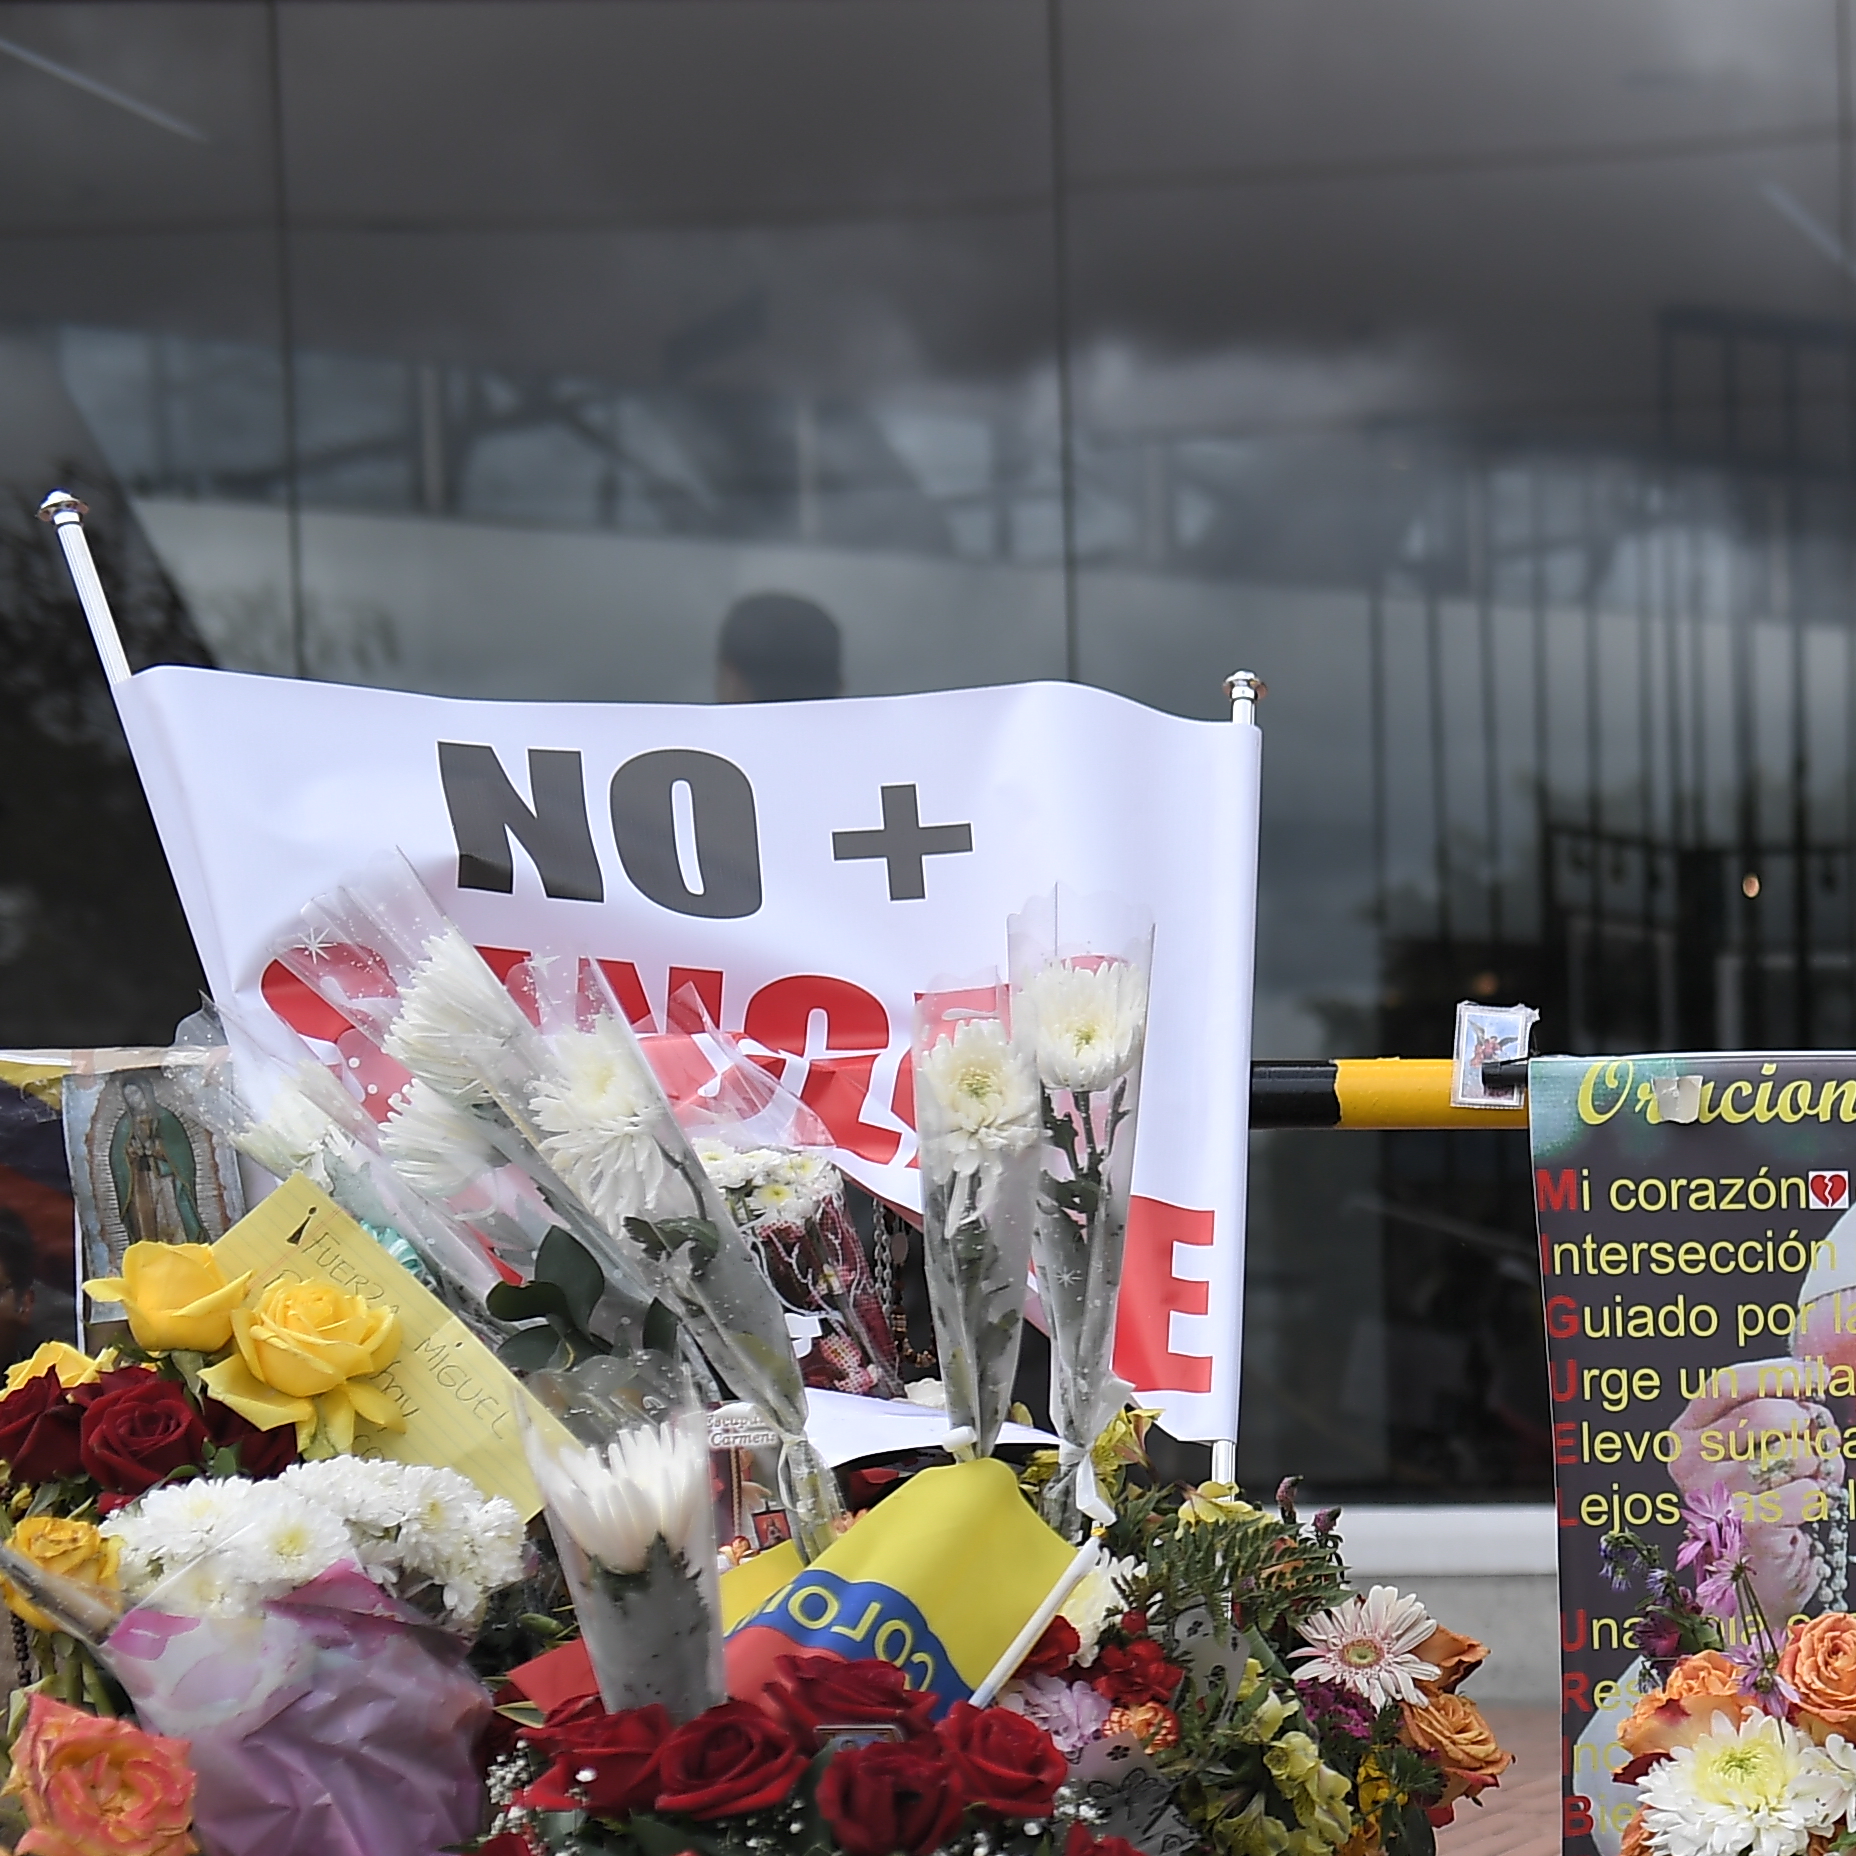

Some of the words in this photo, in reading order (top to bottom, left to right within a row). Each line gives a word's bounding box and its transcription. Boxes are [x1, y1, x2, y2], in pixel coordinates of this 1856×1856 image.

[437, 741, 763, 920] NO
[1536, 1167, 1592, 1212] Mi
[1609, 1167, 1808, 1212] corazón
[1541, 1229, 1838, 1277] Intersección
[1546, 1294, 1719, 1340] Guiado
[1737, 1301, 1814, 1347] por
[1550, 1358, 1660, 1412] Urge
[1680, 1367, 1738, 1399] un
[1554, 1420, 1683, 1465] Elevo
[1557, 1482, 1681, 1535] Lejos
[1732, 1490, 1783, 1522] as
[1802, 1490, 1829, 1523] a
